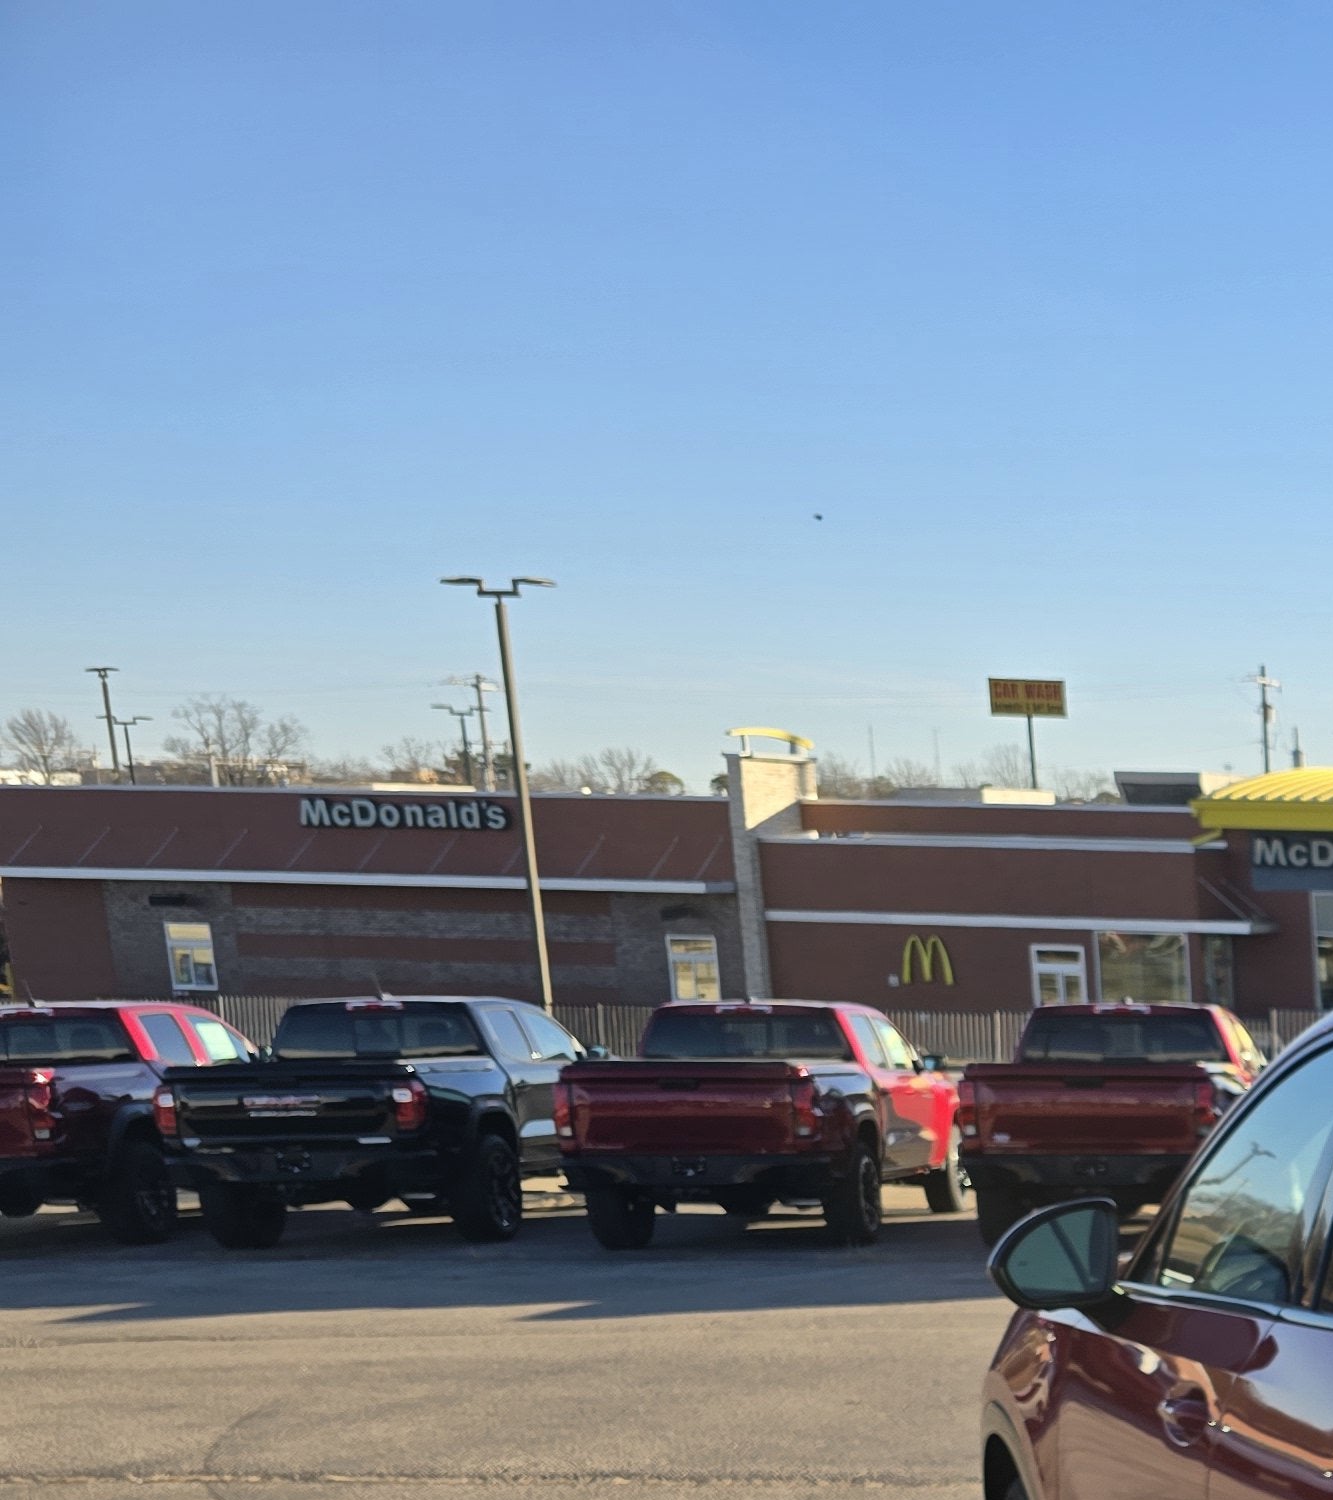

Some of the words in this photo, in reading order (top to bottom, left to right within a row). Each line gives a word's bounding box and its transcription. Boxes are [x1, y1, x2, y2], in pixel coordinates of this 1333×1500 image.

[992, 682, 1019, 699] CAR
[1024, 682, 1062, 701] WASH
[300, 798, 507, 829] McDonald's
